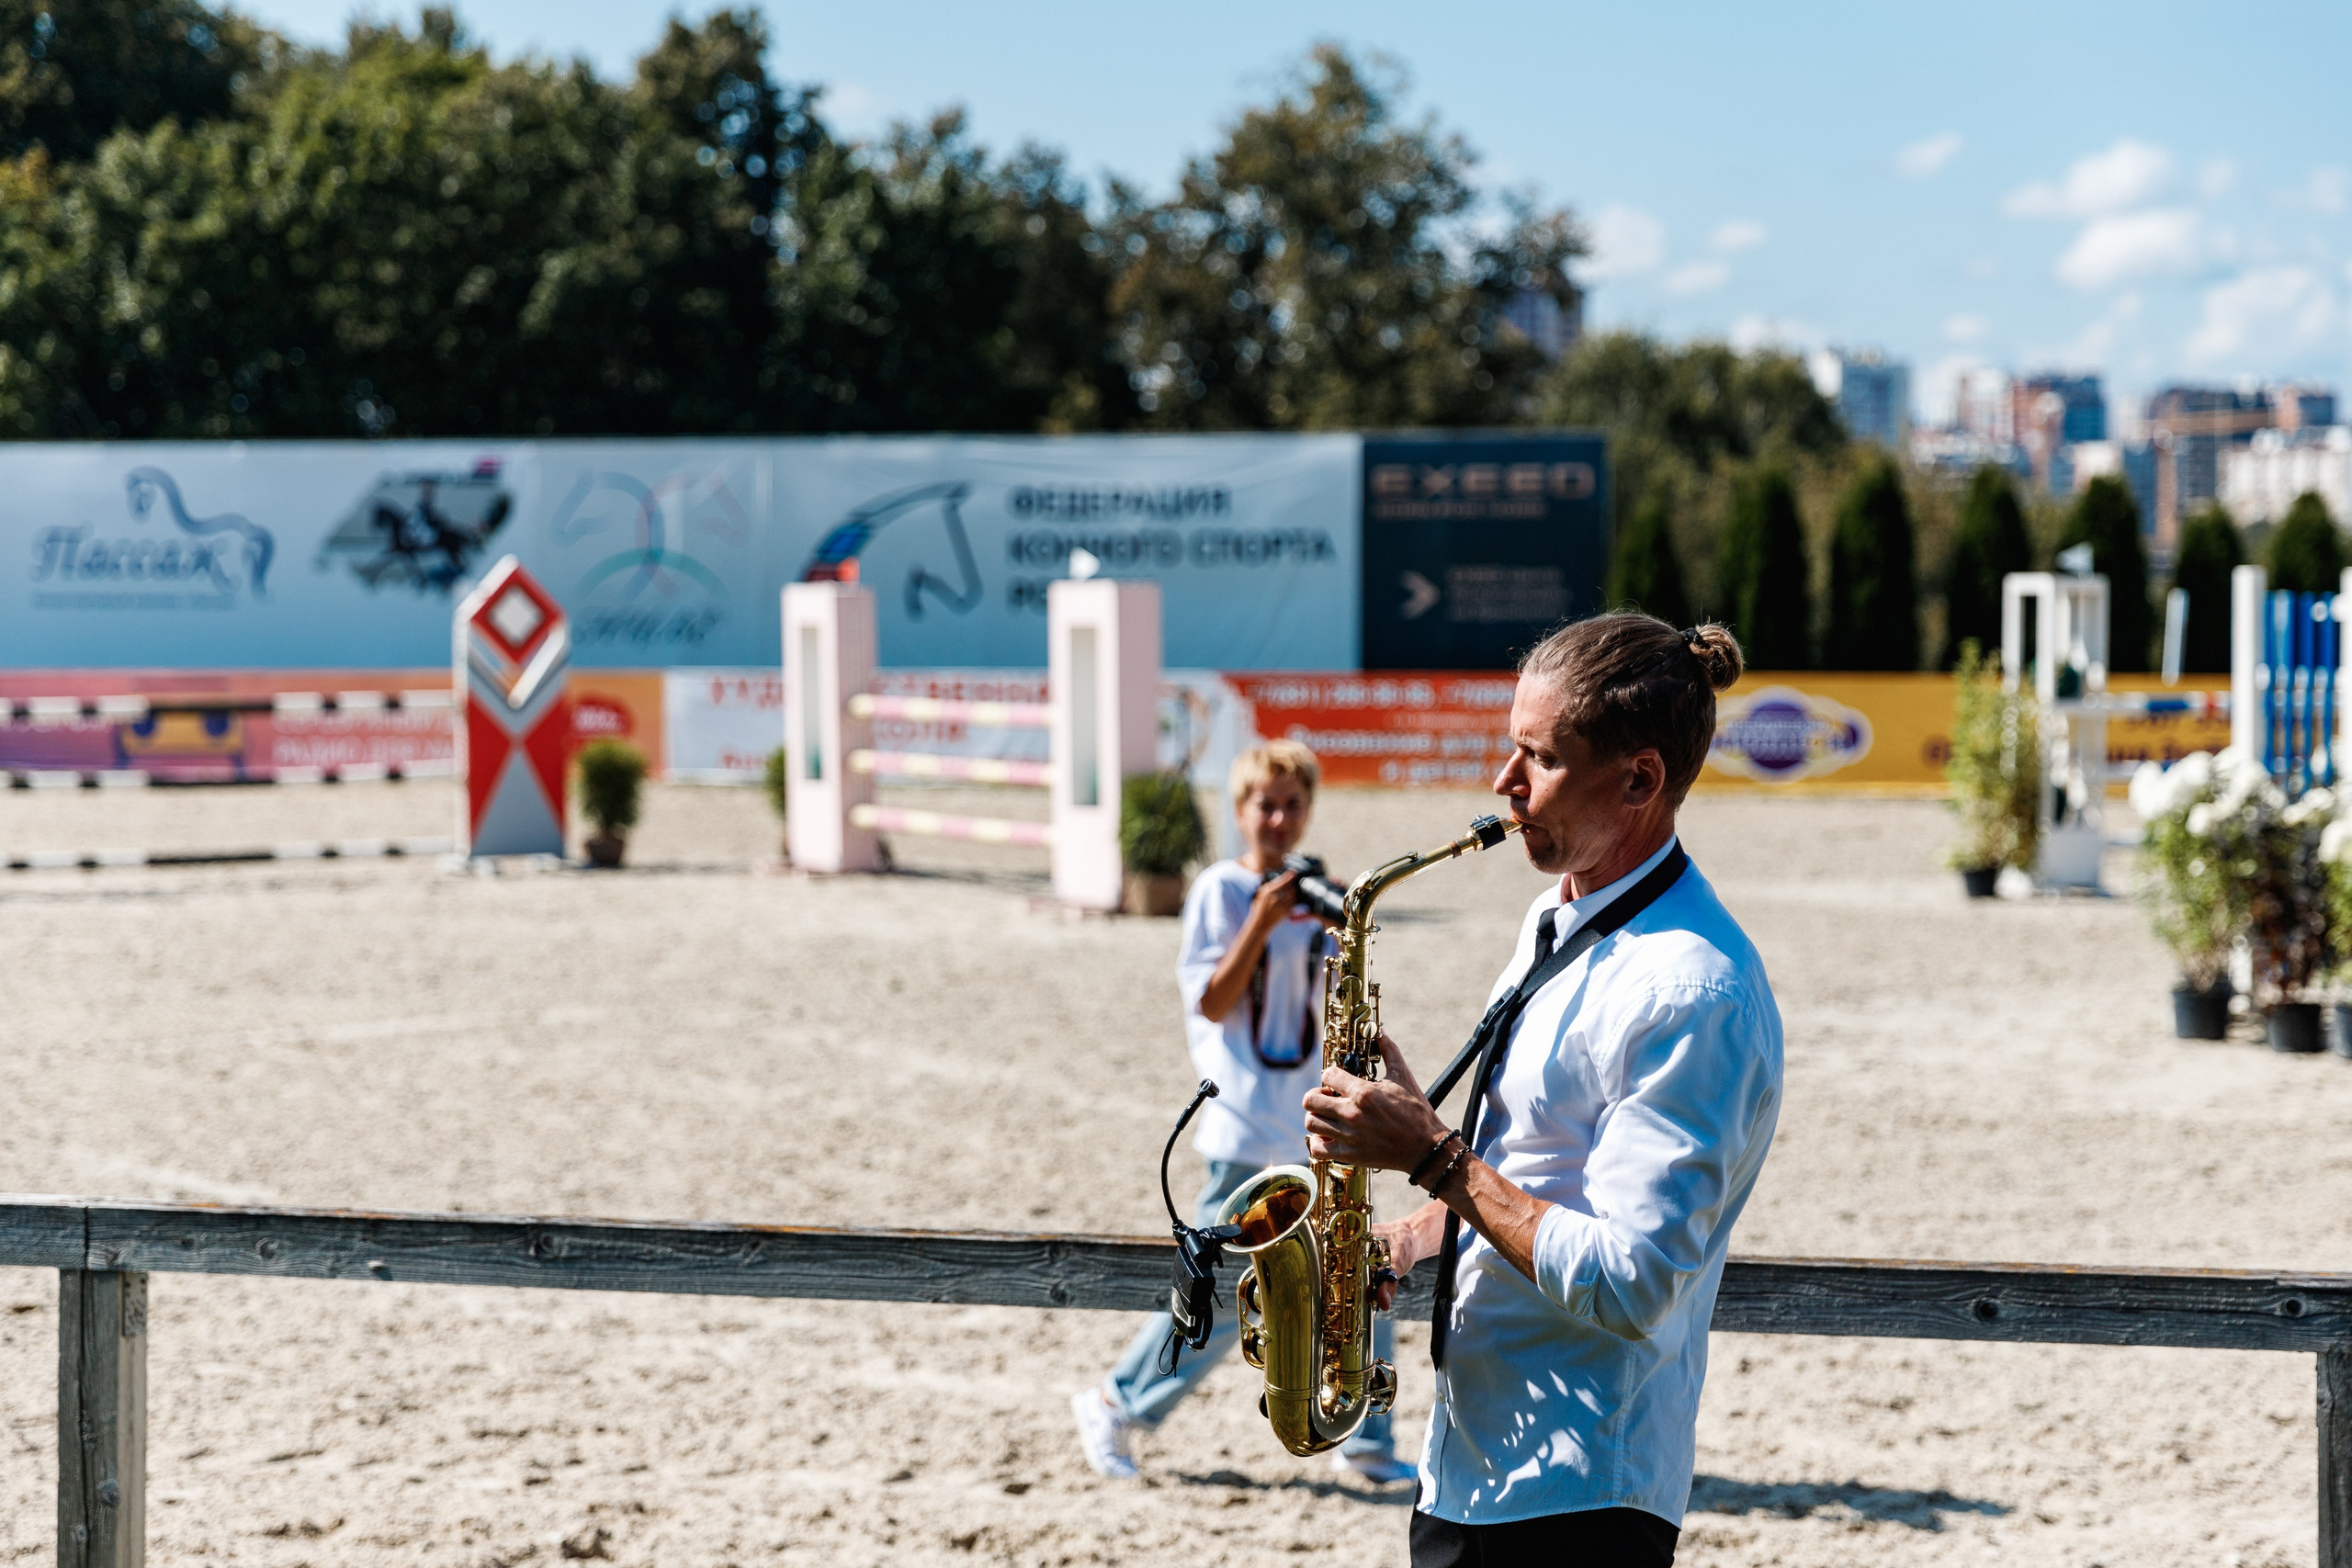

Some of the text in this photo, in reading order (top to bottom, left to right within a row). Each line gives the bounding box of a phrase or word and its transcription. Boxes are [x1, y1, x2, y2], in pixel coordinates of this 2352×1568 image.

[1373, 462, 1597, 500] EXEED
[1007, 484, 1231, 521] ФЕДЕРАЦИЯ
[1189, 527, 1334, 567] СПОРТА
